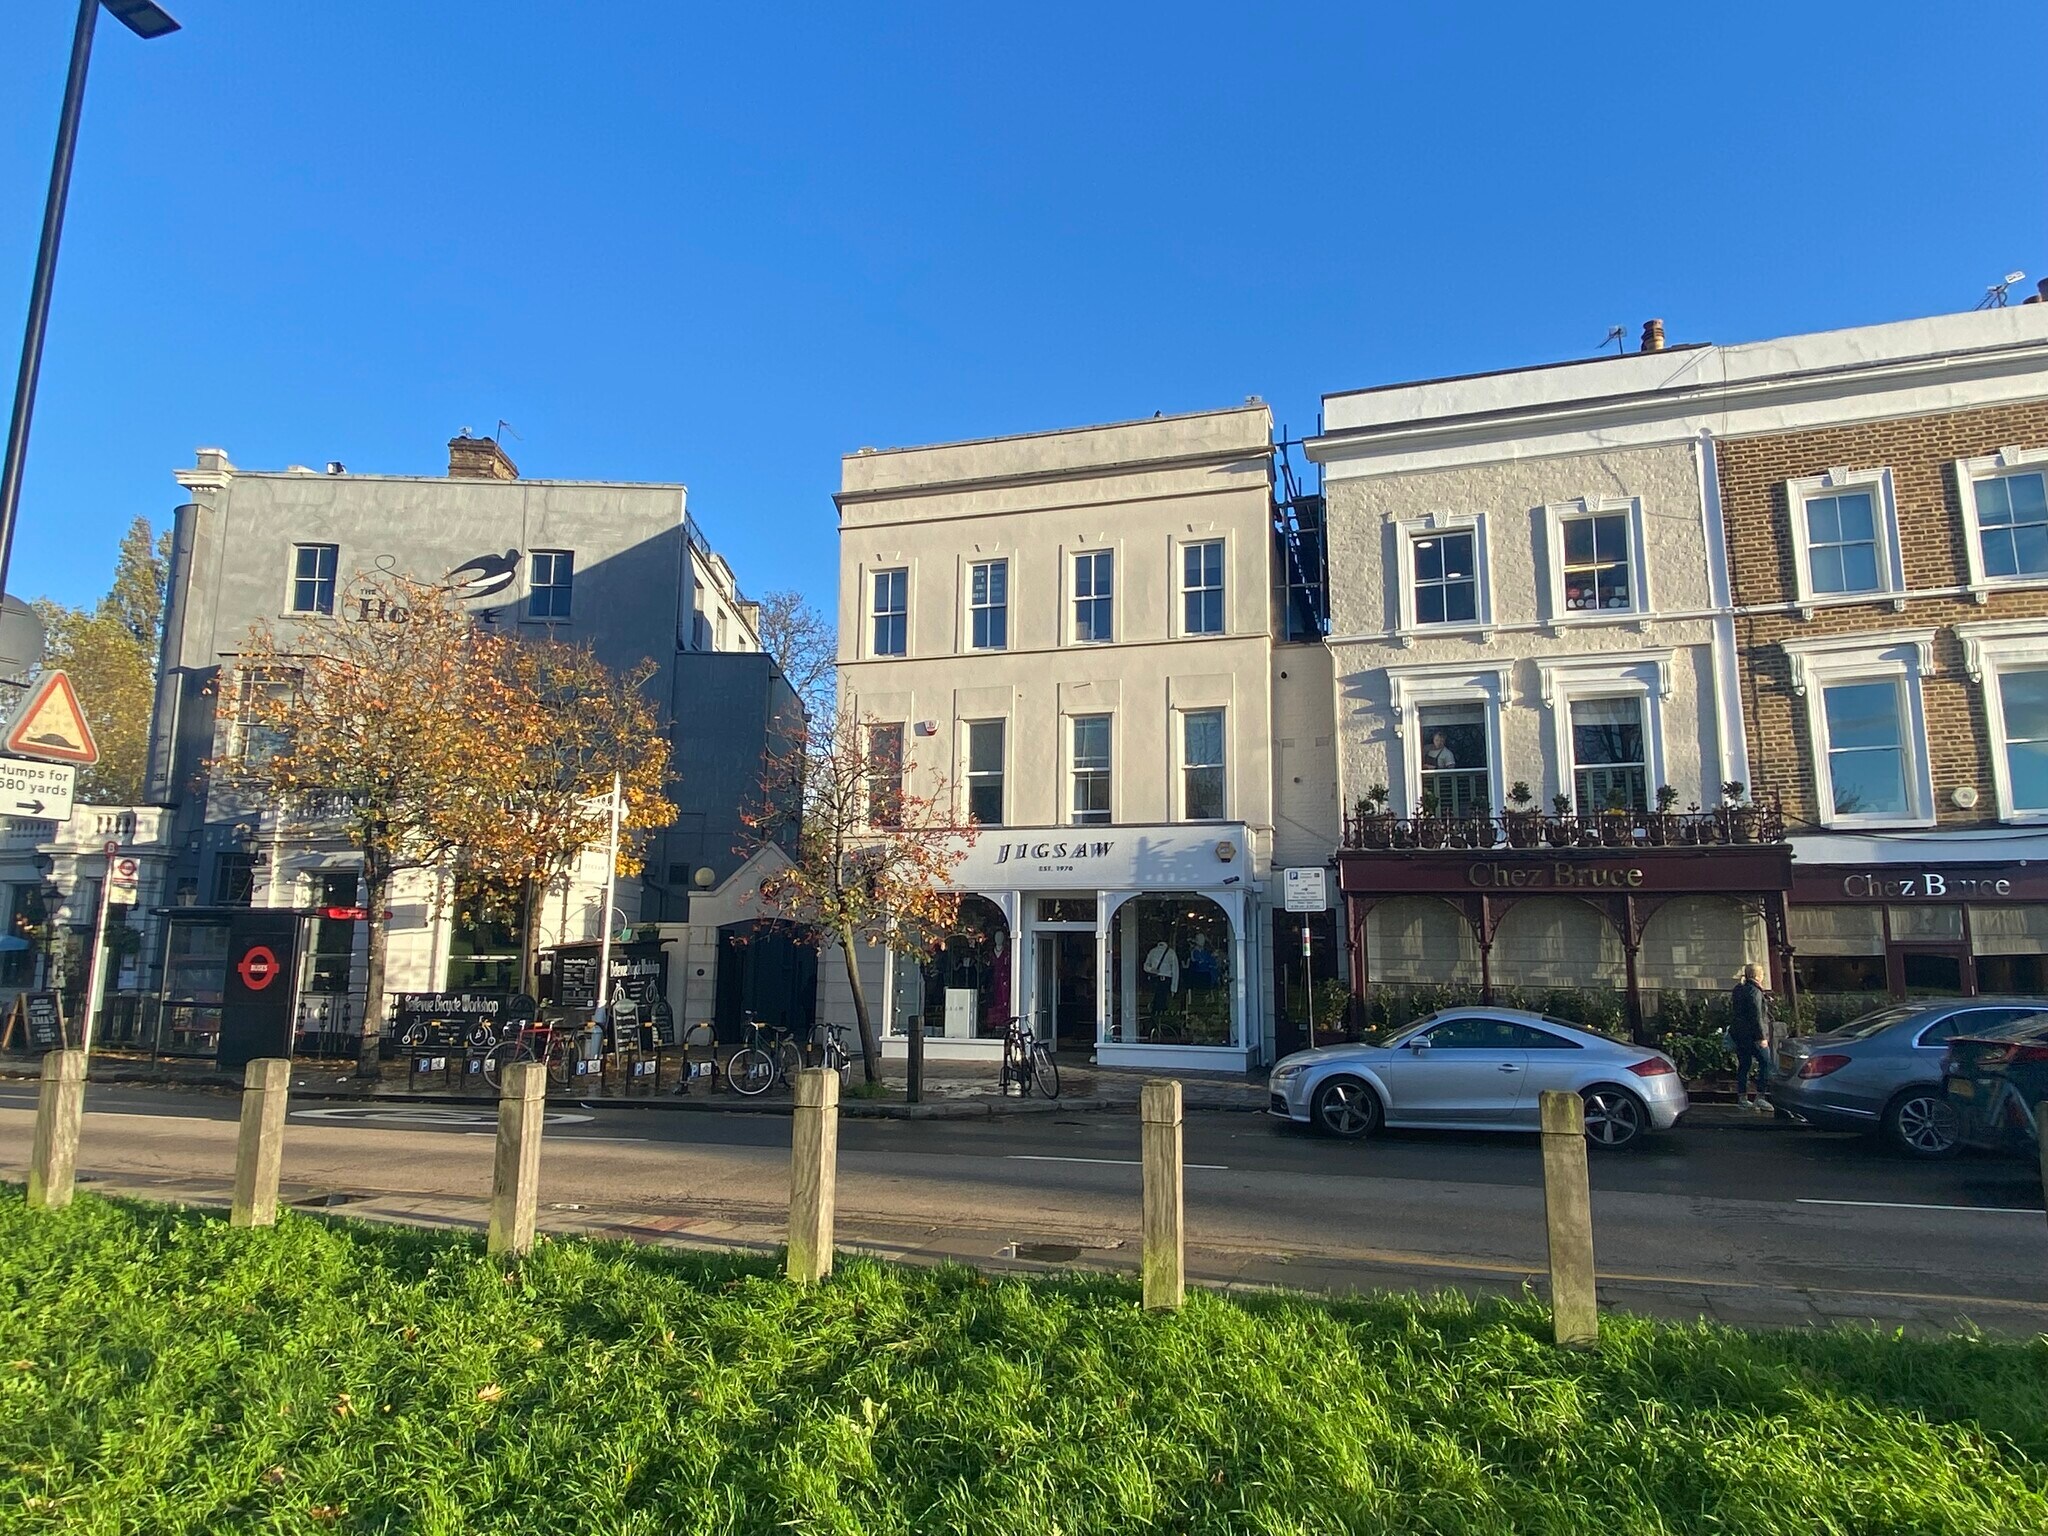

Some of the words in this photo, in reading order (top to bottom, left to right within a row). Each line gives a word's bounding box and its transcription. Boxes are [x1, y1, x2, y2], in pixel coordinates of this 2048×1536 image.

[0, 763, 45, 779] Humps
[49, 770, 69, 781] for
[30, 784, 67, 796] yards
[994, 841, 1114, 864] JIGSAW
[1468, 862, 1543, 887] Chez
[1554, 862, 1643, 887] Bruce
[1843, 874, 1916, 897] Chez
[1922, 873, 2011, 897] Bruce
[405, 995, 434, 1012] Bellevue
[435, 994, 461, 1016] Bicycle
[462, 994, 499, 1017] Workshop
